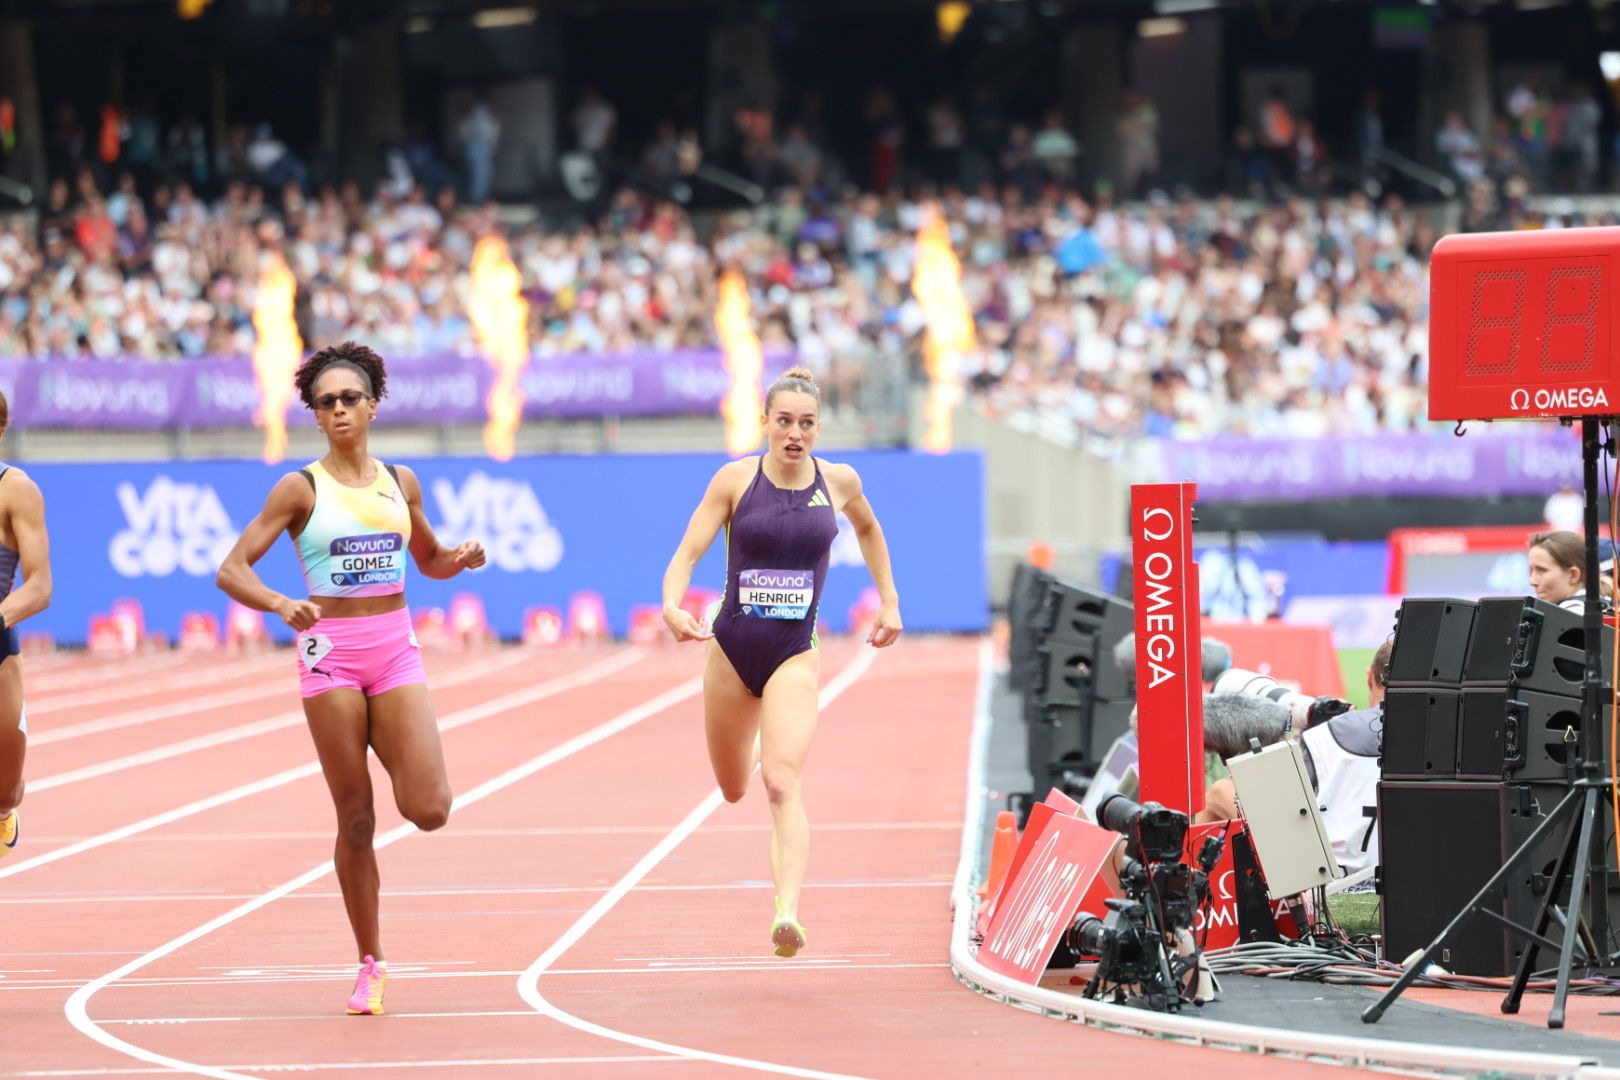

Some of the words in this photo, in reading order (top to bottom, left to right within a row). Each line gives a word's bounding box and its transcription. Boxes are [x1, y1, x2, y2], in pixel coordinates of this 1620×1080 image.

[384, 372, 477, 410] ovuna
[1534, 387, 1609, 409] OMEGA
[116, 475, 236, 542] VITA
[431, 469, 553, 536] VITA
[336, 538, 395, 553] Novuna
[342, 555, 394, 571] GOMEZ
[358, 571, 397, 583] LONDON
[746, 572, 805, 587] Novuna
[749, 592, 804, 604] HENRICH
[765, 607, 804, 617] LONDON
[1144, 552, 1177, 689] OMEGA
[307, 638, 317, 656] 2
[1361, 805, 1378, 853] 7
[1001, 855, 1088, 972] OMEGA
[1188, 899, 1292, 931] OMA
